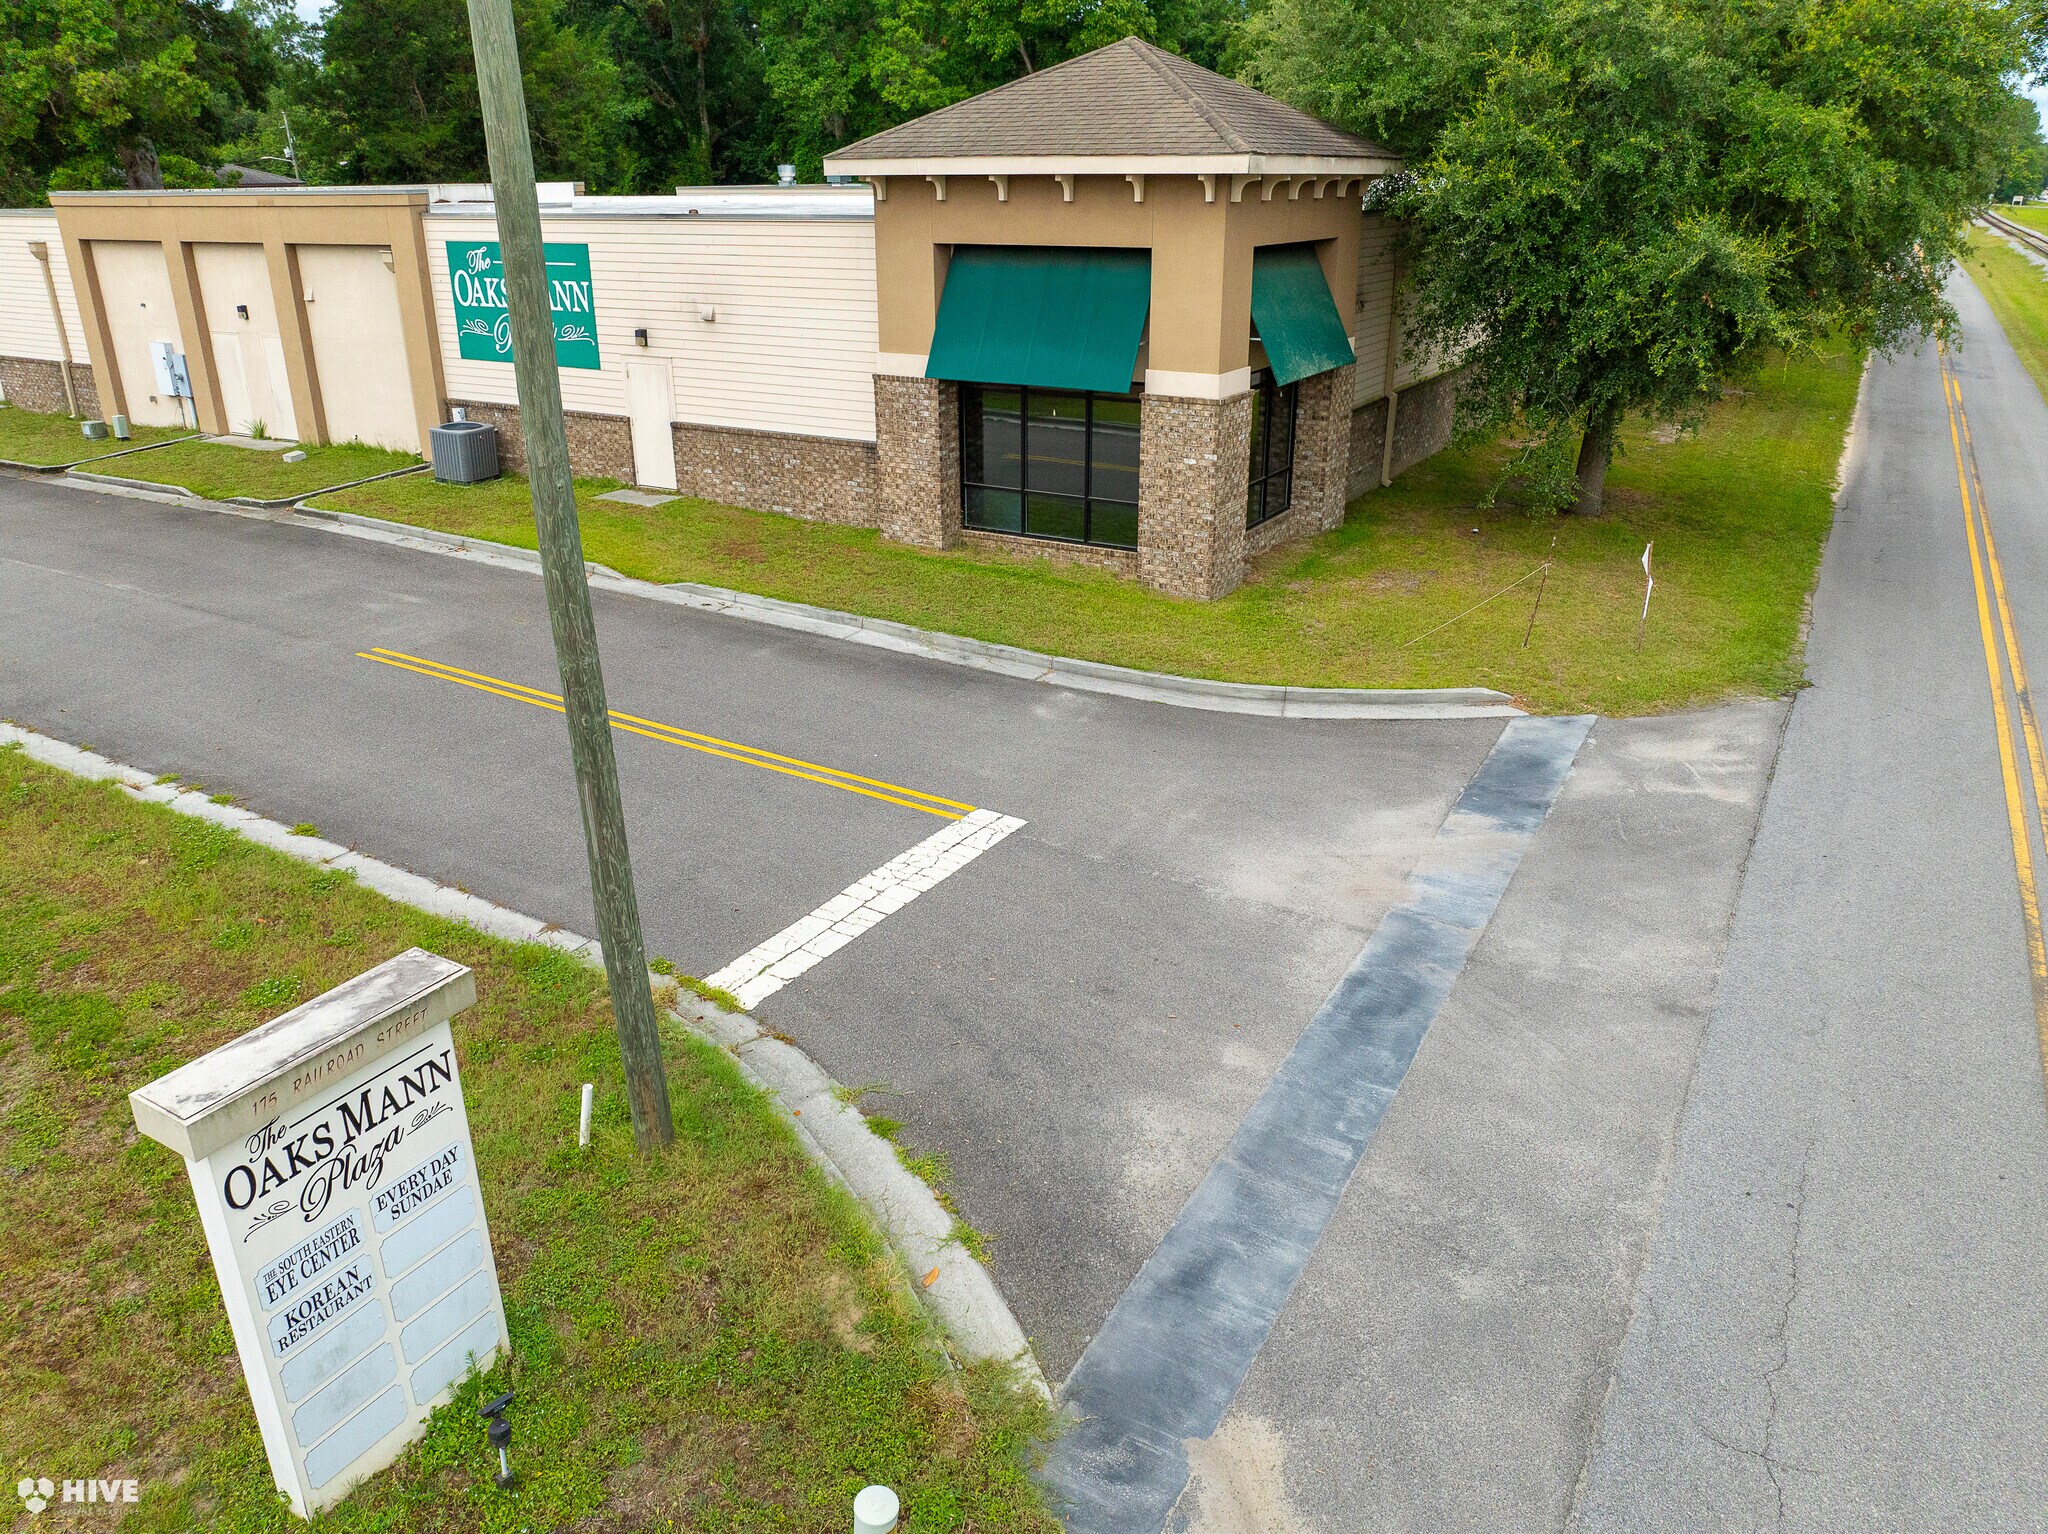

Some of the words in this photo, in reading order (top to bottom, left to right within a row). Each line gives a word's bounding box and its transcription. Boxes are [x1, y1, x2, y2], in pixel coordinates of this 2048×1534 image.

[466, 246, 491, 275] The
[252, 1091, 278, 1116] 175
[293, 1043, 365, 1096] RAILROAD
[376, 1006, 429, 1049] STREET
[223, 1120, 335, 1211] OAKS
[336, 1049, 452, 1146] MANN
[245, 1116, 287, 1163] The
[300, 1124, 405, 1222] Plaza
[376, 1165, 427, 1212] EVERY
[430, 1146, 458, 1177] DAY
[391, 1169, 453, 1220] SUNDAE
[263, 1270, 278, 1283] THE
[278, 1245, 312, 1273] SOUTH
[312, 1214, 355, 1251] EASTERN
[265, 1269, 299, 1304] EYE
[300, 1227, 361, 1279] CENTER
[277, 1275, 373, 1352] RESTAURANT
[284, 1265, 360, 1331] KOREAN
